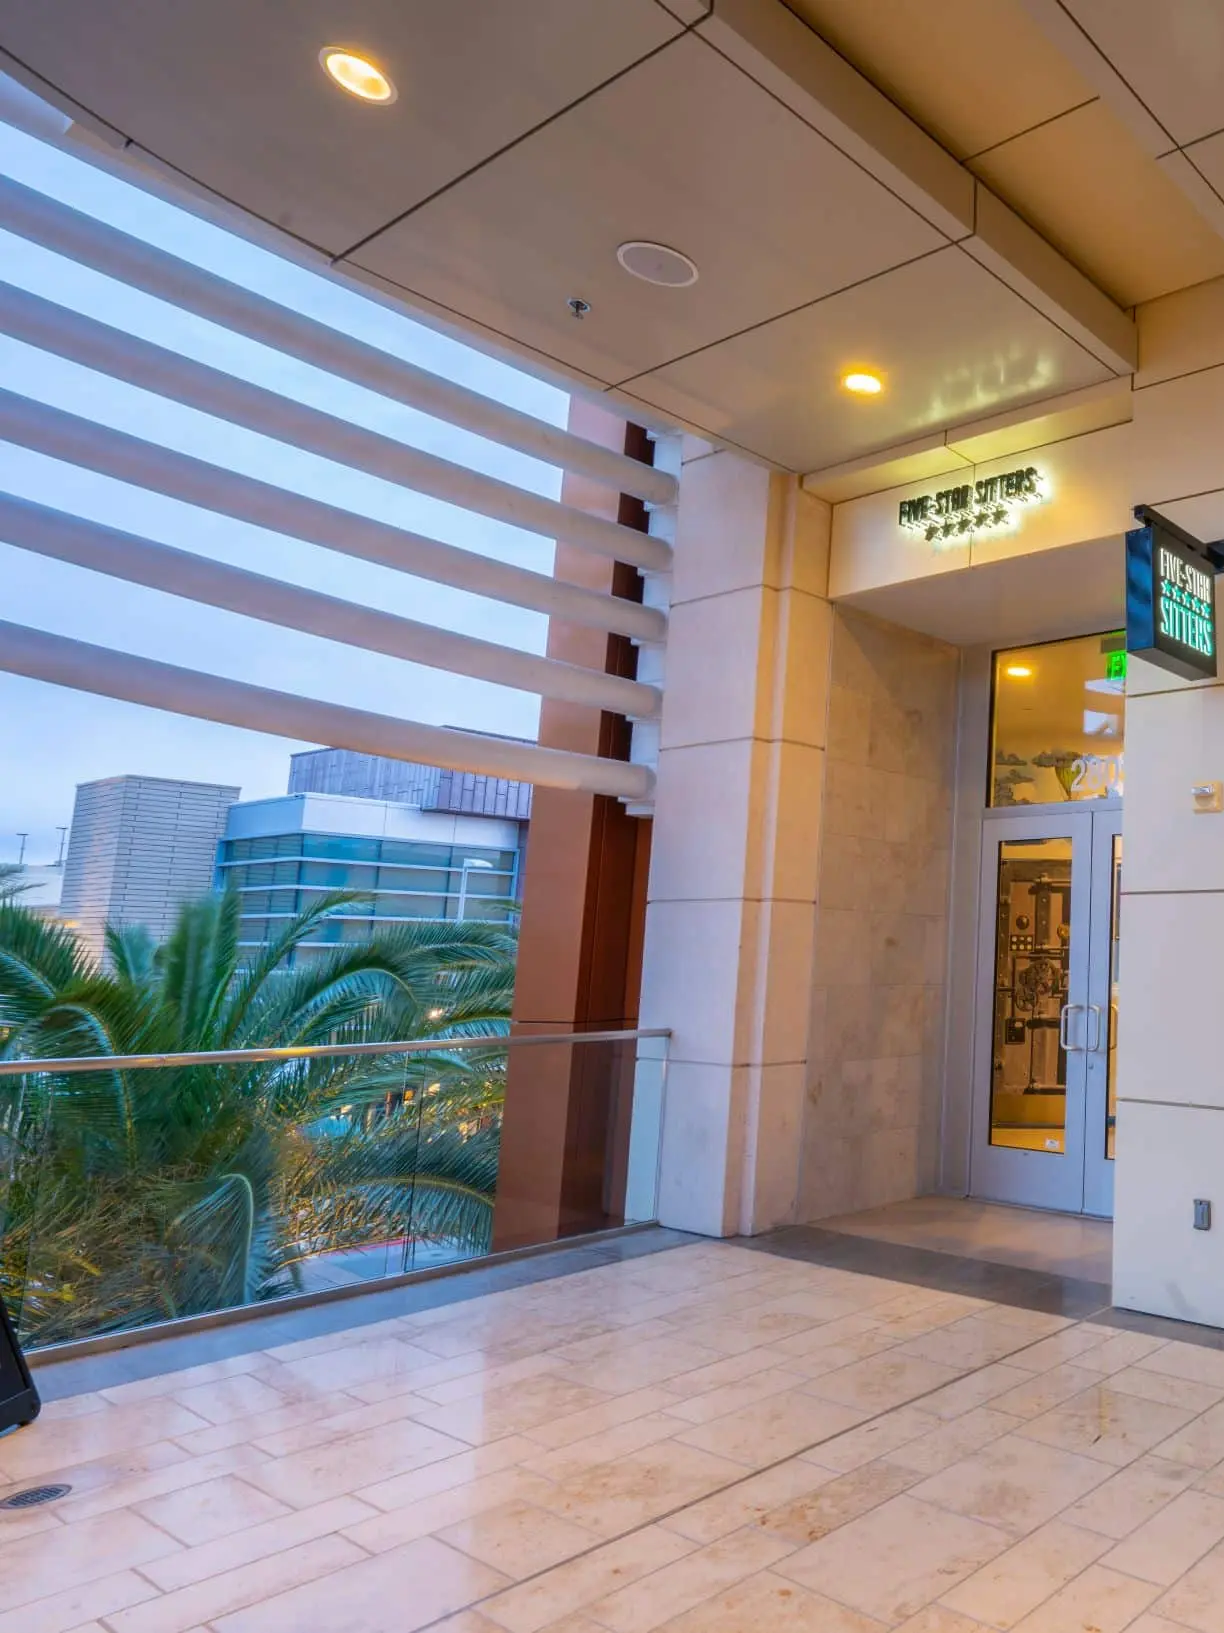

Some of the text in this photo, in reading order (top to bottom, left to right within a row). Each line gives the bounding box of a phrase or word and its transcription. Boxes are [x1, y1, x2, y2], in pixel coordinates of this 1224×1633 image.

[899, 466, 1038, 526] FIVE-STAR SITTERS
[1160, 547, 1211, 604] FIVE-STAR
[1160, 596, 1213, 656] SITTERS
